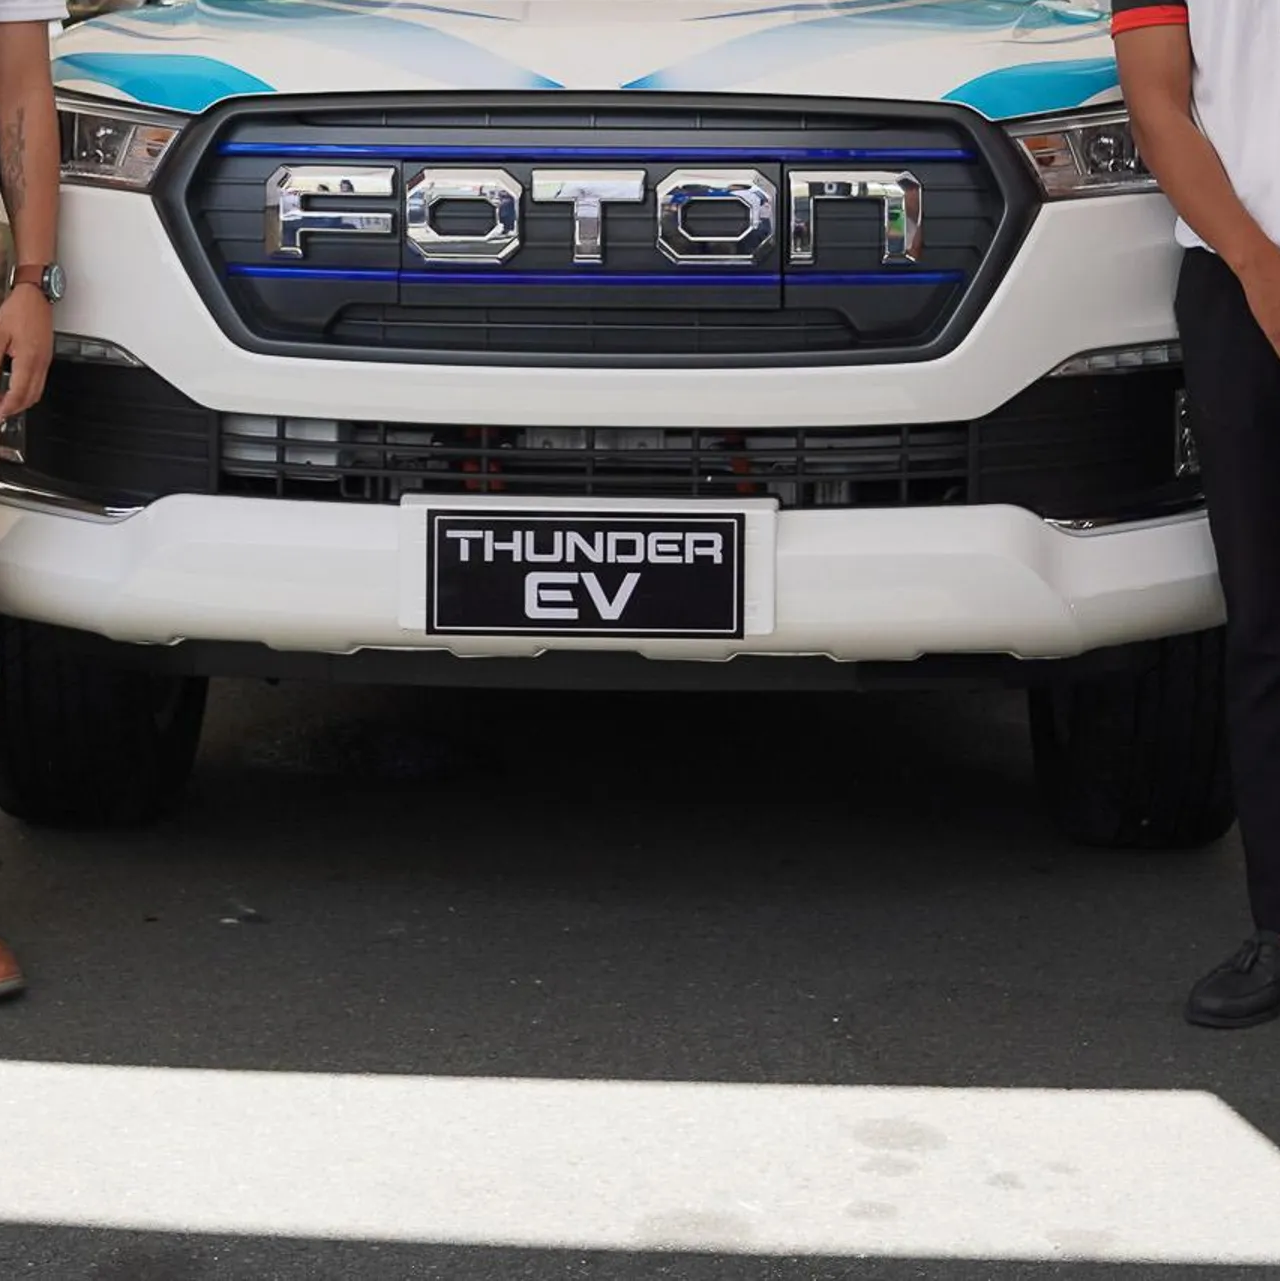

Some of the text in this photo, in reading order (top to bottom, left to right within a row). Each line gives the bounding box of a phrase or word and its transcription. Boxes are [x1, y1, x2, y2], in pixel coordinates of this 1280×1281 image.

[264, 164, 923, 266] FOTON
[446, 528, 725, 566] THUNDER
[523, 570, 642, 621] EV
